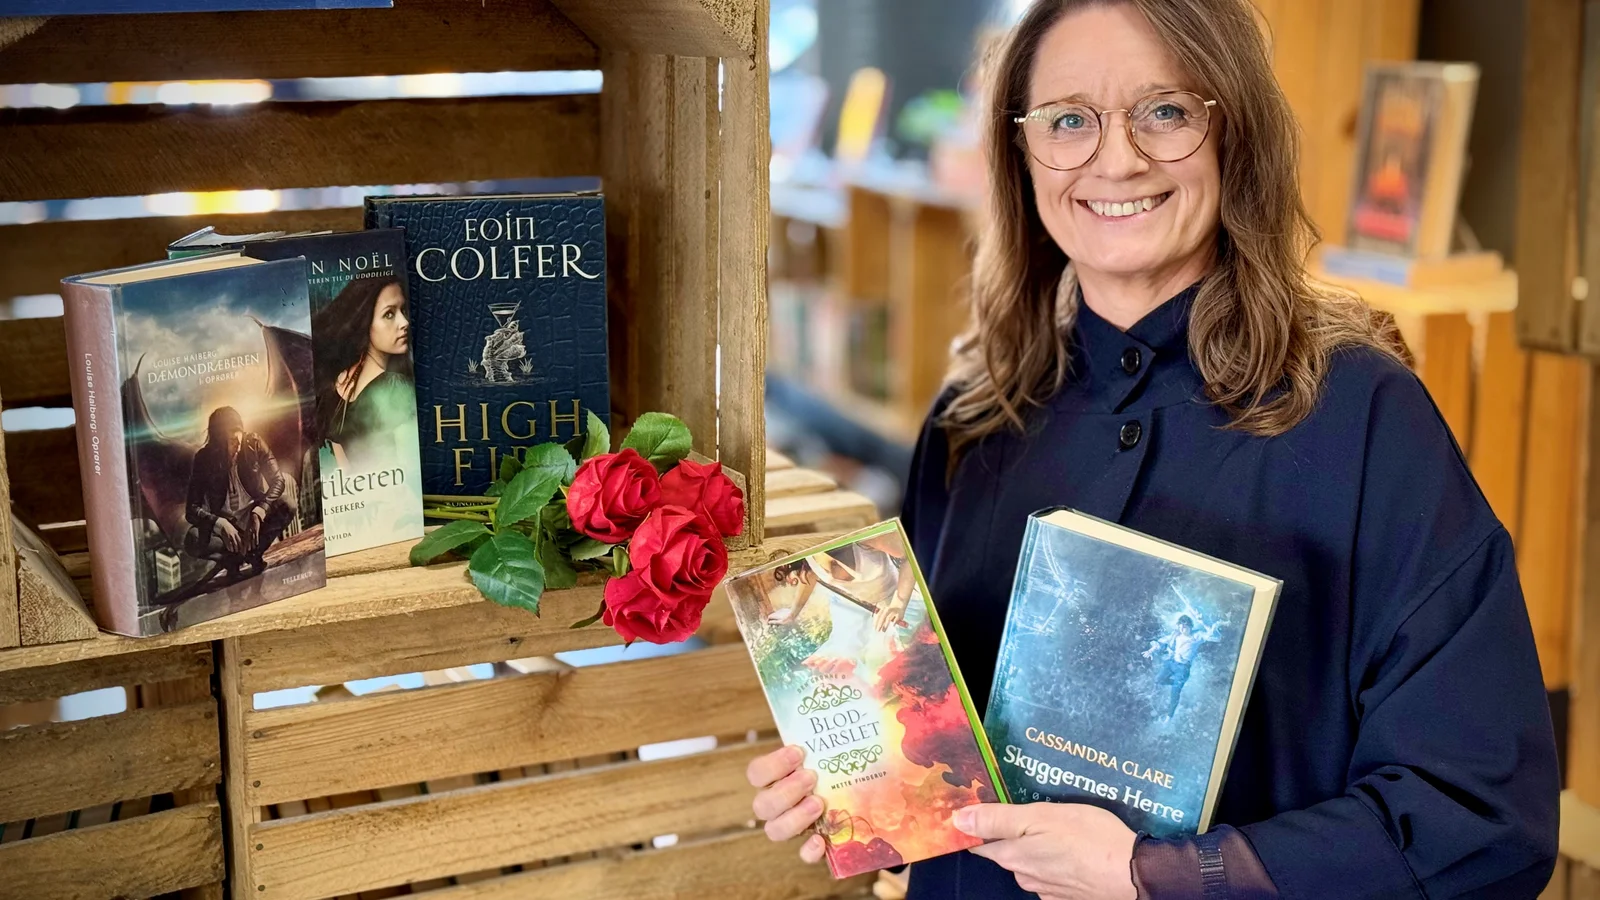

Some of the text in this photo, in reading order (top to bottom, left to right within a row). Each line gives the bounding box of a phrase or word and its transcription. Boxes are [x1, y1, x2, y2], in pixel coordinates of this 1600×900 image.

[339, 252, 392, 272] NOËL
[415, 244, 600, 282] COLFER
[332, 274, 343, 282] TIL
[345, 273, 354, 281] DE
[355, 270, 394, 280] UDØDELIGE
[147, 353, 260, 384] DÆMONDRÆBEREN
[153, 350, 218, 369] LOUISE HAIBERG
[84, 353, 101, 476] Louise Haiberg: Oprører
[433, 399, 582, 443] HIGH
[330, 501, 366, 514] SEEKERS
[324, 532, 352, 542] ALVILDA
[282, 571, 314, 585] TELLERUP
[809, 709, 868, 734] BLOD-
[804, 721, 881, 753] VARSLET
[1025, 727, 1175, 789] CASSANDRA CLARE
[830, 771, 887, 790] METTE FINDERUP
[1003, 745, 1185, 823] Skyggernes Herre
